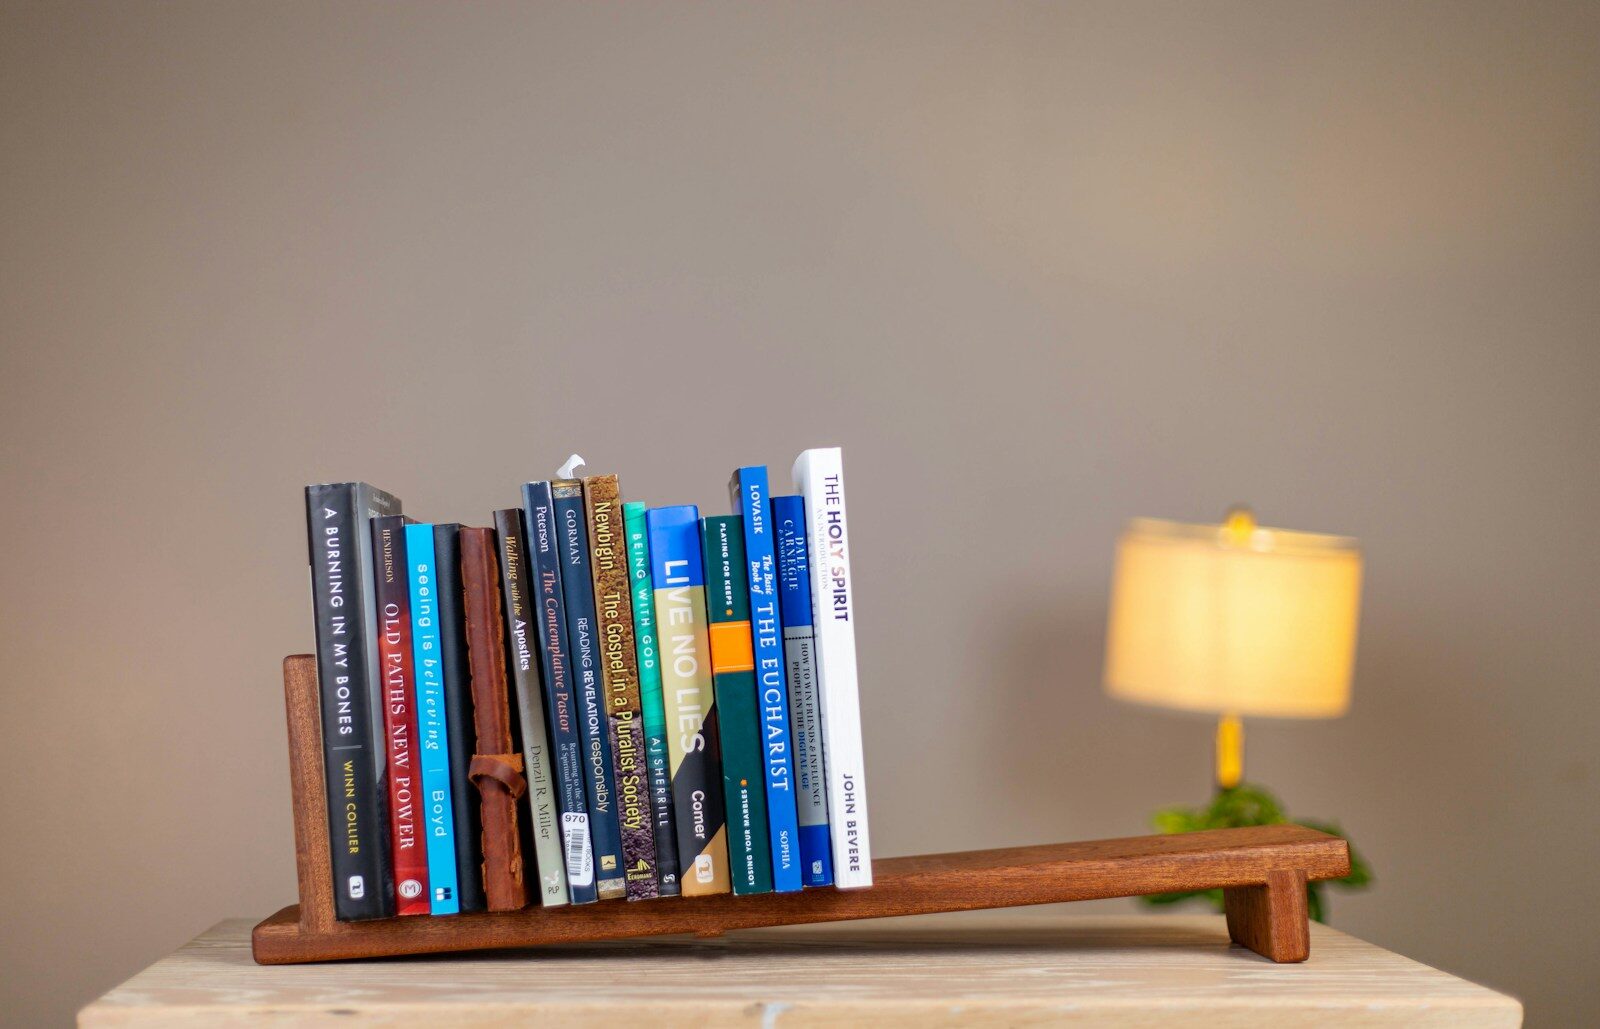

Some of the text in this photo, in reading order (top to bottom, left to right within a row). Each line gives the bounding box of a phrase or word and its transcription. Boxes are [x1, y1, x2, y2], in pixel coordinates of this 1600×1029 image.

[536, 506, 550, 553] Peterson
[750, 484, 763, 535] LOVASIK
[382, 529, 394, 583] HENDERSON
[566, 509, 581, 565] GORMAN
[594, 502, 614, 571] Newbigin
[784, 519, 799, 592] CARNEGIE
[795, 537, 807, 572] DALE
[824, 474, 849, 621] THE HOLY SPIRIT
[719, 523, 733, 606] PLAYING FOR KEEPS
[751, 560, 764, 595] Book of
[761, 554, 774, 596] The Basic
[324, 508, 353, 735] A BURNING IN MY BONES
[505, 535, 531, 671] Walking with the Apostles
[632, 534, 654, 669] BEING WITH GOD
[417, 563, 442, 751] seeing is believing
[543, 570, 570, 733] The Contemplative Pastor
[664, 559, 706, 754] LIVE NO LIES
[792, 661, 801, 694] PEOPLE
[803, 668, 810, 679] TO
[577, 618, 609, 813] READING REVELATION responsibly
[602, 592, 643, 830] The Gospel in a Pluralist Society
[757, 602, 789, 792] THE EUCHARIST
[804, 681, 812, 702] WIN
[384, 603, 415, 850] OLD PATHS NEW POWER
[799, 731, 809, 768] DIGITAL
[806, 703, 816, 744] FRIENDS
[530, 745, 545, 784] Denzil
[802, 769, 810, 791] AGE
[809, 754, 821, 807] INFLUENCE
[343, 760, 360, 855] WINN COLLIER
[431, 790, 448, 838] Boyd
[654, 758, 669, 826] SHERRILL
[691, 790, 706, 840] Comer
[741, 789, 751, 828] MARBLES
[537, 801, 552, 840] Miller
[565, 815, 586, 824] 970
[843, 774, 861, 872] JOHN BEVERE
[747, 854, 755, 886] LOSING
[780, 830, 791, 870] SOPHIA
